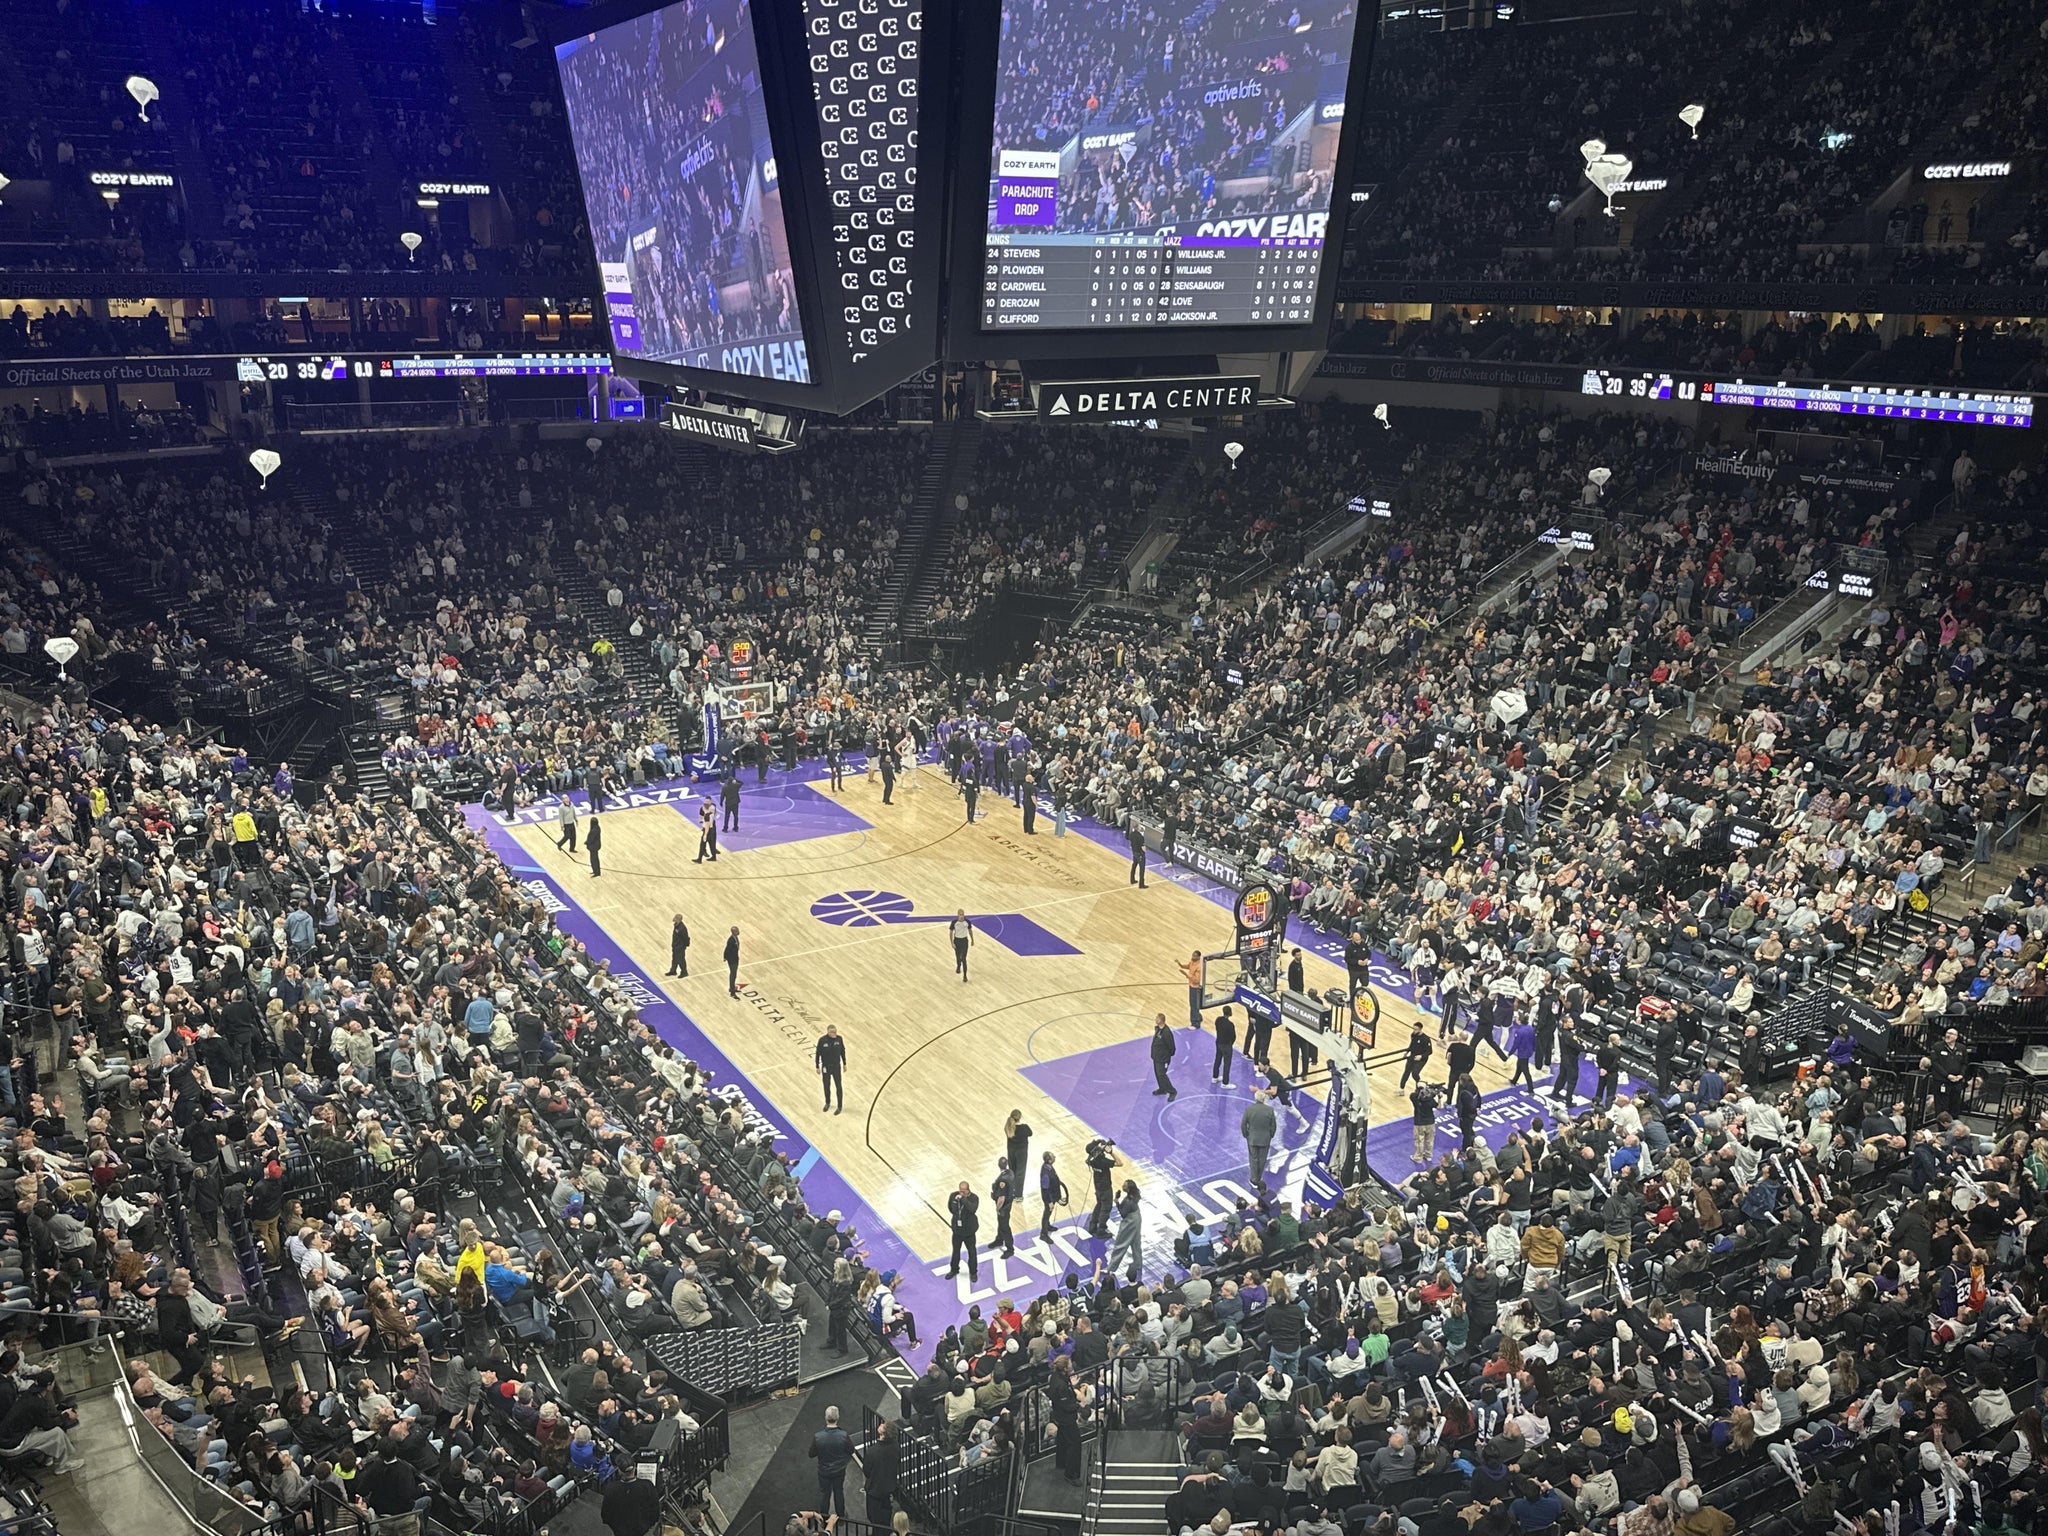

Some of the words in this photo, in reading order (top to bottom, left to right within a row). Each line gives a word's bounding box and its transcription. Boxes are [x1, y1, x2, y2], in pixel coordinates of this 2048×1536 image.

[1238, 78, 1262, 99] lofts
[1083, 135, 1108, 150] COZY
[1003, 160, 1025, 169] COZY
[1028, 161, 1056, 170] EARTH
[1924, 165, 1962, 178] COZY
[1962, 162, 2010, 177] EARTH
[91, 173, 128, 184] COZY
[129, 174, 173, 186] EARTH
[1607, 181, 1633, 192] COZY
[1634, 180, 1667, 191] EARTH
[420, 183, 451, 193] COZY
[452, 184, 490, 194] EARTH
[1001, 185, 1054, 199] PARACHUTE
[1014, 203, 1039, 217] DROP
[1197, 217, 1266, 237] COZY
[1269, 212, 1329, 237] EAR
[986, 234, 1010, 245] KINGS
[1164, 237, 1182, 246] JAZZ
[988, 249, 999, 258] 24
[1003, 249, 1040, 258] STEVENS
[1136, 250, 1147, 258] 05
[1166, 250, 1172, 258] 0
[1178, 250, 1214, 258] WILLIAMS
[1298, 250, 1307, 259] 04
[987, 266, 998, 274] 29
[1002, 266, 1044, 274] PLOWDEN
[1135, 266, 1145, 274] 05
[1165, 266, 1170, 274] 5
[1176, 266, 1212, 274] WILLIAMS
[1296, 266, 1305, 274] 07
[986, 282, 996, 291] 32
[1001, 282, 1046, 291] CARDWELL
[1133, 282, 1144, 291] 05
[1161, 281, 1170, 290] 28
[1174, 281, 1224, 290] SENSABAUGH
[986, 299, 995, 307] 10
[1000, 299, 1040, 307] DEROZAN
[1133, 298, 1141, 306] 10
[1159, 297, 1169, 306] 42
[1172, 297, 1193, 306] LOVE
[1291, 296, 1301, 305] 05
[987, 315, 992, 323] 5
[999, 315, 1039, 323] CLIFFORD
[1131, 314, 1140, 322] 12
[1157, 312, 1167, 321] 20
[1171, 312, 1206, 321] JACKSON
[1251, 310, 1260, 319] 10
[722, 344, 765, 377] COZY
[7, 368, 59, 386] Official
[61, 368, 100, 381] Sheets
[103, 366, 119, 379] of
[120, 365, 144, 379] the
[146, 365, 179, 378] Utah
[182, 364, 212, 377] Jazz
[268, 363, 288, 379] 20
[298, 363, 317, 378] 39
[354, 362, 373, 377] 0.0
[400, 368, 418, 376] 15/24
[444, 368, 458, 376] 6/12
[459, 368, 476, 376] (50%)
[485, 368, 497, 376] 3/3
[498, 368, 516, 376] (100%)
[1427, 366, 1462, 381] Official
[1517, 371, 1541, 384] Utah
[1542, 373, 1564, 386] Jazz
[1606, 378, 1622, 395] 20
[1630, 379, 1647, 396] 39
[1678, 382, 1696, 399] 0.0
[1703, 383, 1713, 392] 24
[1077, 391, 1157, 413] DELTA
[1166, 387, 1252, 408] CENTER
[1722, 384, 1737, 393] 7/29
[1996, 404, 2006, 412] 74
[2013, 405, 2027, 414] 143
[1719, 394, 1737, 403] 15/24
[1763, 398, 1777, 406] 6/12
[1777, 398, 1796, 408] (50%)
[1806, 401, 1819, 410] 3/3
[1819, 402, 1841, 412] (100%)
[1868, 406, 1875, 414] 15
[1885, 407, 1892, 415] 17
[1902, 408, 1910, 416] 14
[1976, 414, 1984, 422] 16
[1993, 415, 2006, 424] 143
[2013, 416, 2024, 425] 74
[679, 414, 711, 435] DELTA
[712, 421, 750, 443] CENTER
[1695, 457, 1775, 481] HealthEquity
[1844, 478, 1874, 486] AMERICA
[1874, 481, 1894, 489] FIRST
[1842, 573, 1871, 586] COZY
[1838, 583, 1873, 598] EARTH
[733, 642, 750, 650] 12:00
[732, 650, 749, 664] 24
[604, 786, 700, 811] JAZZ
[1734, 826, 1760, 840] COZY
[998, 839, 1037, 862] DELTA
[1036, 860, 1085, 887] CENTER
[1250, 930, 1272, 940] TISSOT
[1283, 1002, 1298, 1012] COZY
[1299, 1009, 1319, 1024] EARTH
[743, 988, 782, 1025] DELTA
[780, 1023, 818, 1059] CENT
[1321, 1116, 1336, 1156] AMERICA
[932, 1225, 1093, 1306] JAZZ
[1956, 1283, 1972, 1304] 23
[1934, 1486, 1948, 1510] 5
